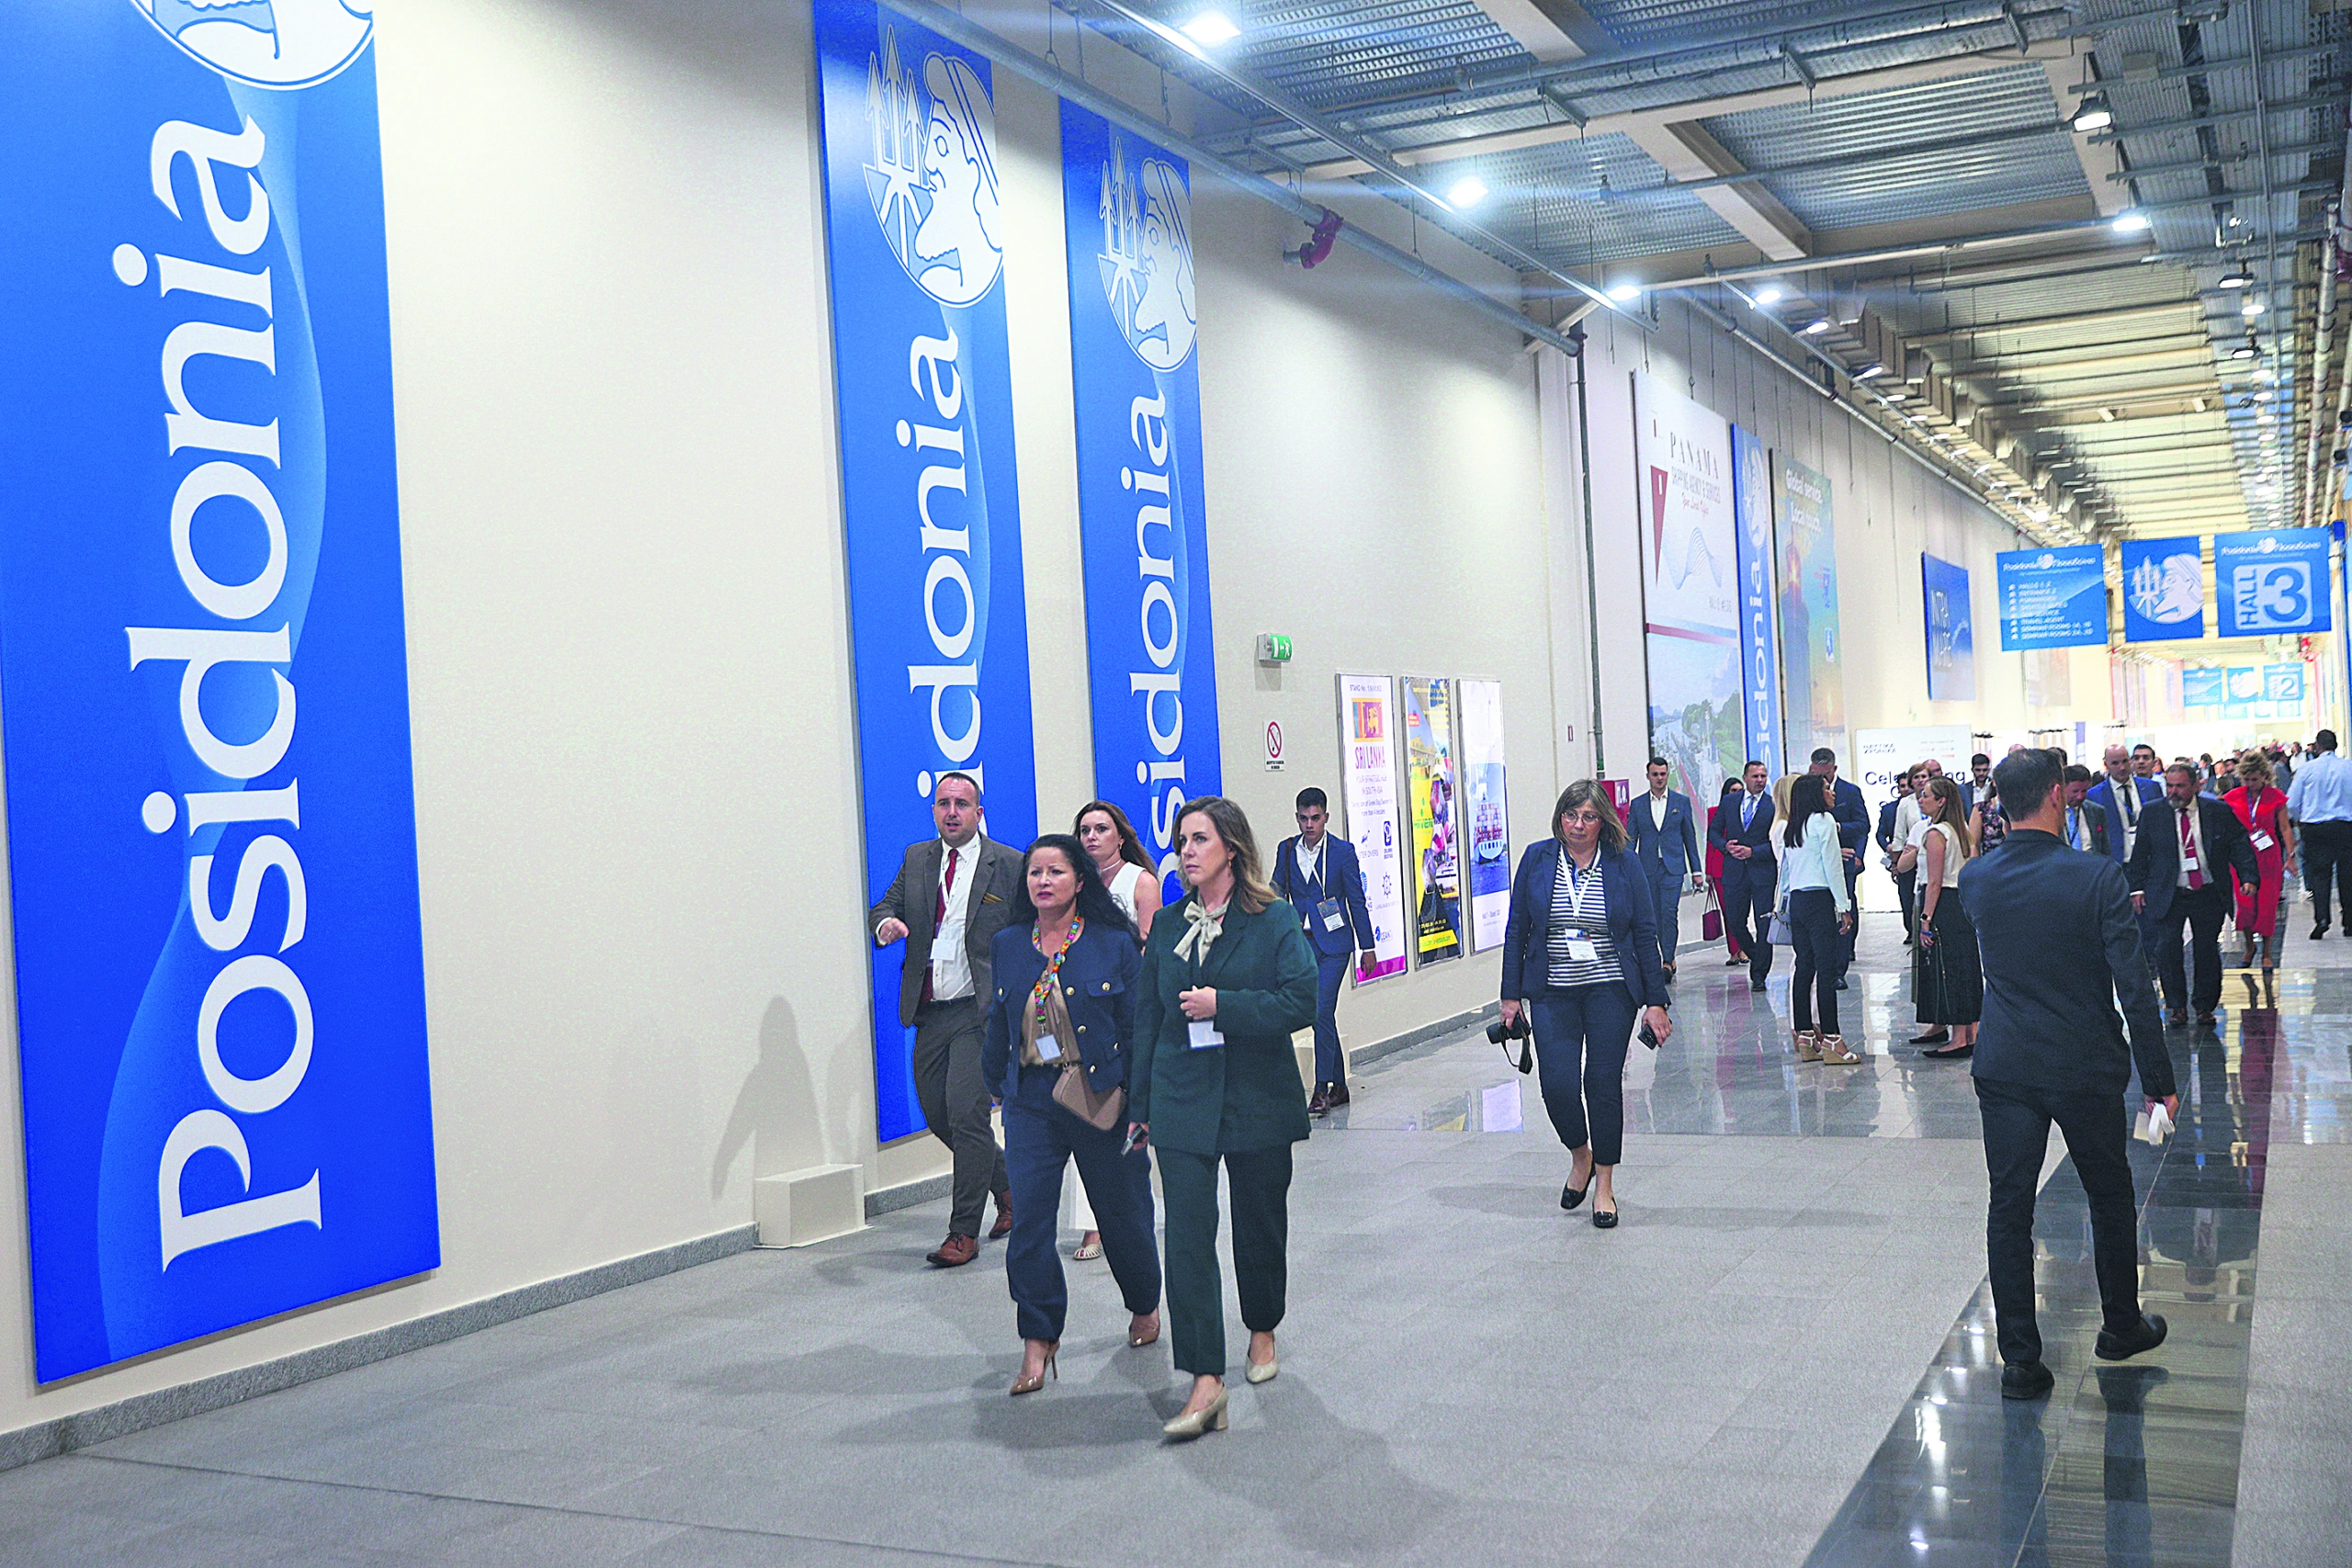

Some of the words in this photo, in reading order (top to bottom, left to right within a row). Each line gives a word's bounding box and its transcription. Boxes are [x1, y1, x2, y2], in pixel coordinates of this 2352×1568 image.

[1670, 432, 1719, 479] PANAMA
[896, 325, 989, 838] idonia
[1120, 387, 1187, 908] sidonia
[2239, 568, 2258, 626] HALL
[2264, 567, 2308, 623] 3
[112, 113, 323, 1273] Posidonia
[1749, 558, 1772, 786] sidonia
[2281, 677, 2295, 697] 2
[1354, 746, 1366, 769] SRI
[1366, 746, 1386, 769] LANKA
